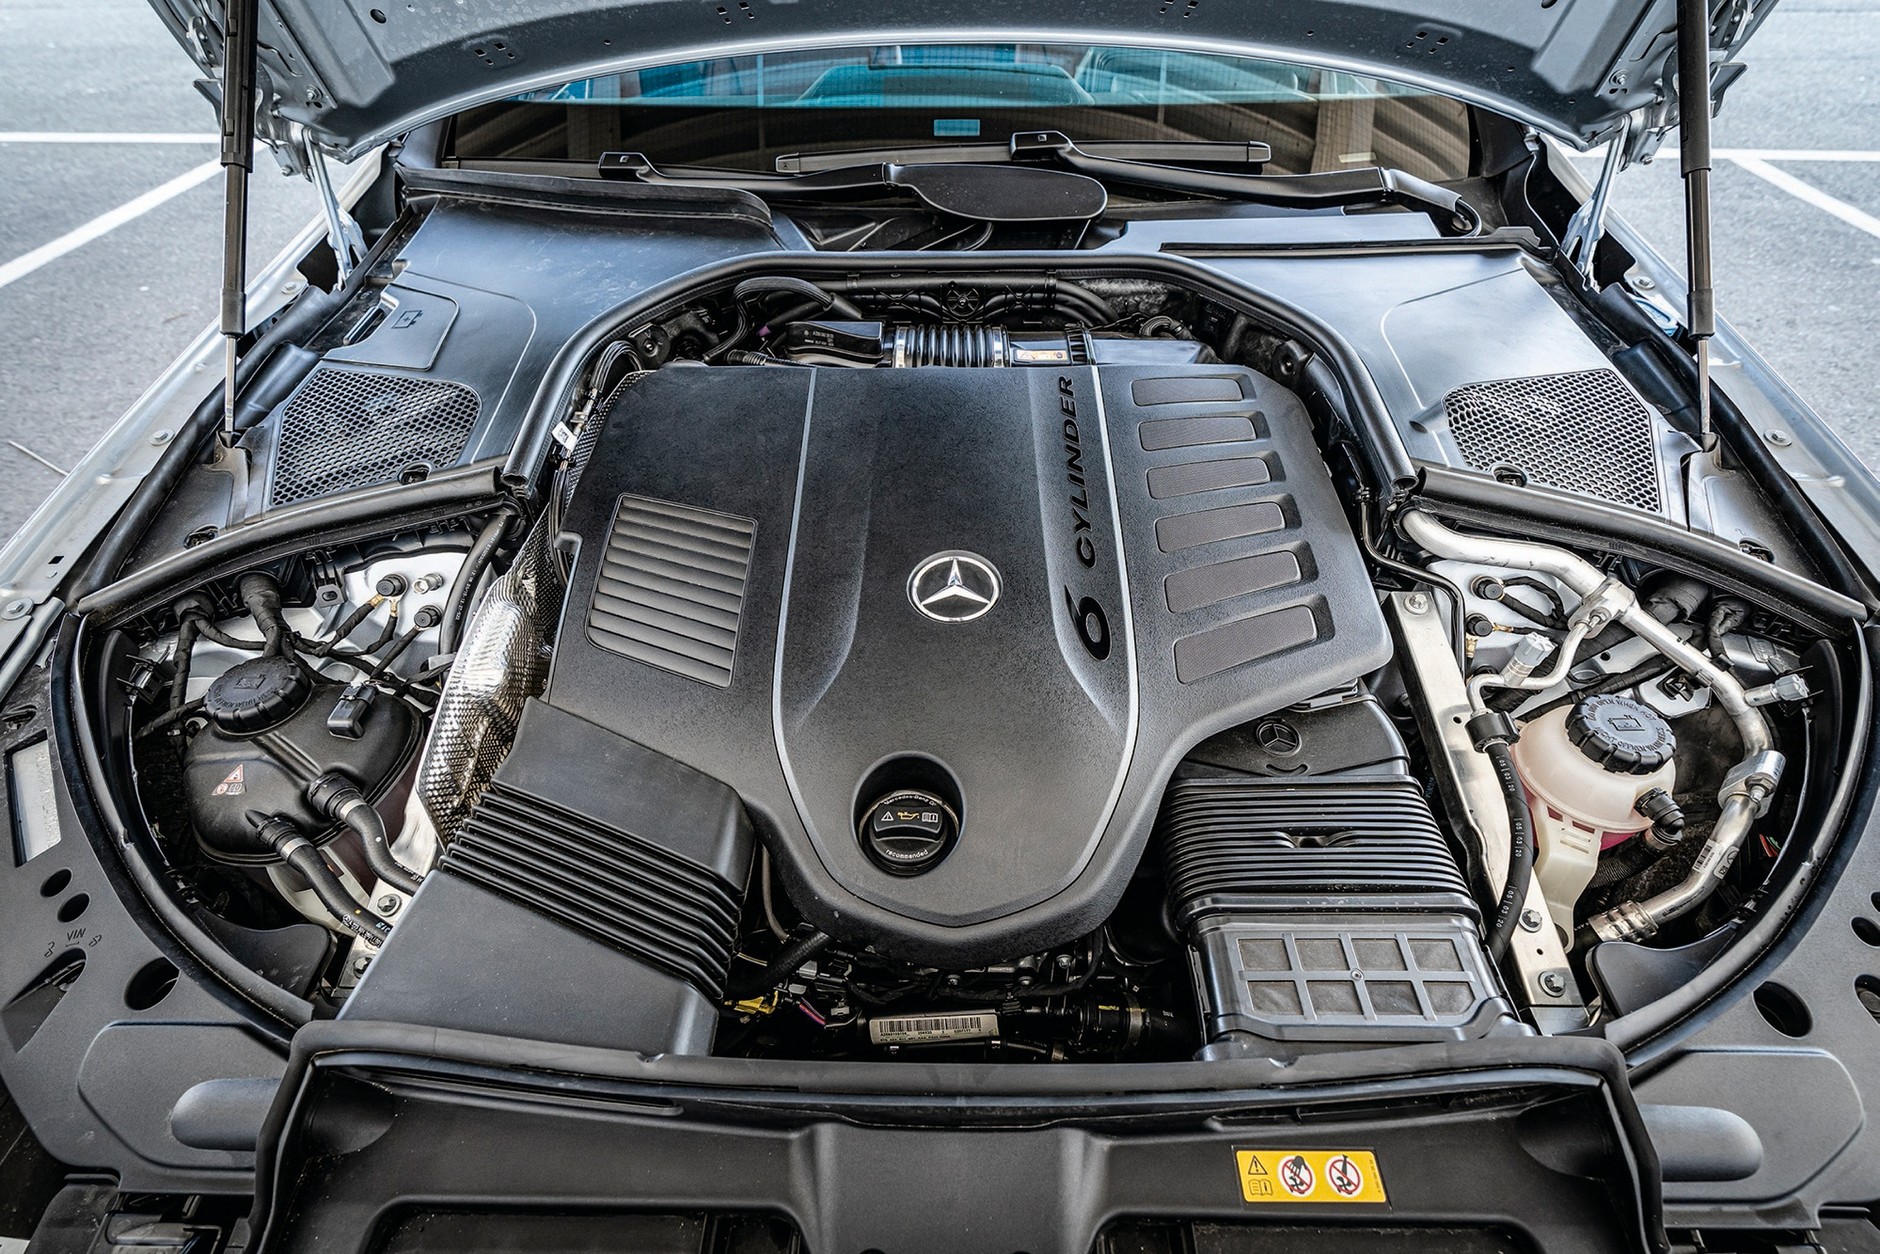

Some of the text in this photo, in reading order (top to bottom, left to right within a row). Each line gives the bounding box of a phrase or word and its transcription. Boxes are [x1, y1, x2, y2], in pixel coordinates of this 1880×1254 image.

[1059, 376, 1112, 661] 6 CYLINDER
[885, 849, 929, 860] recommended
[67, 928, 87, 941] VIN
